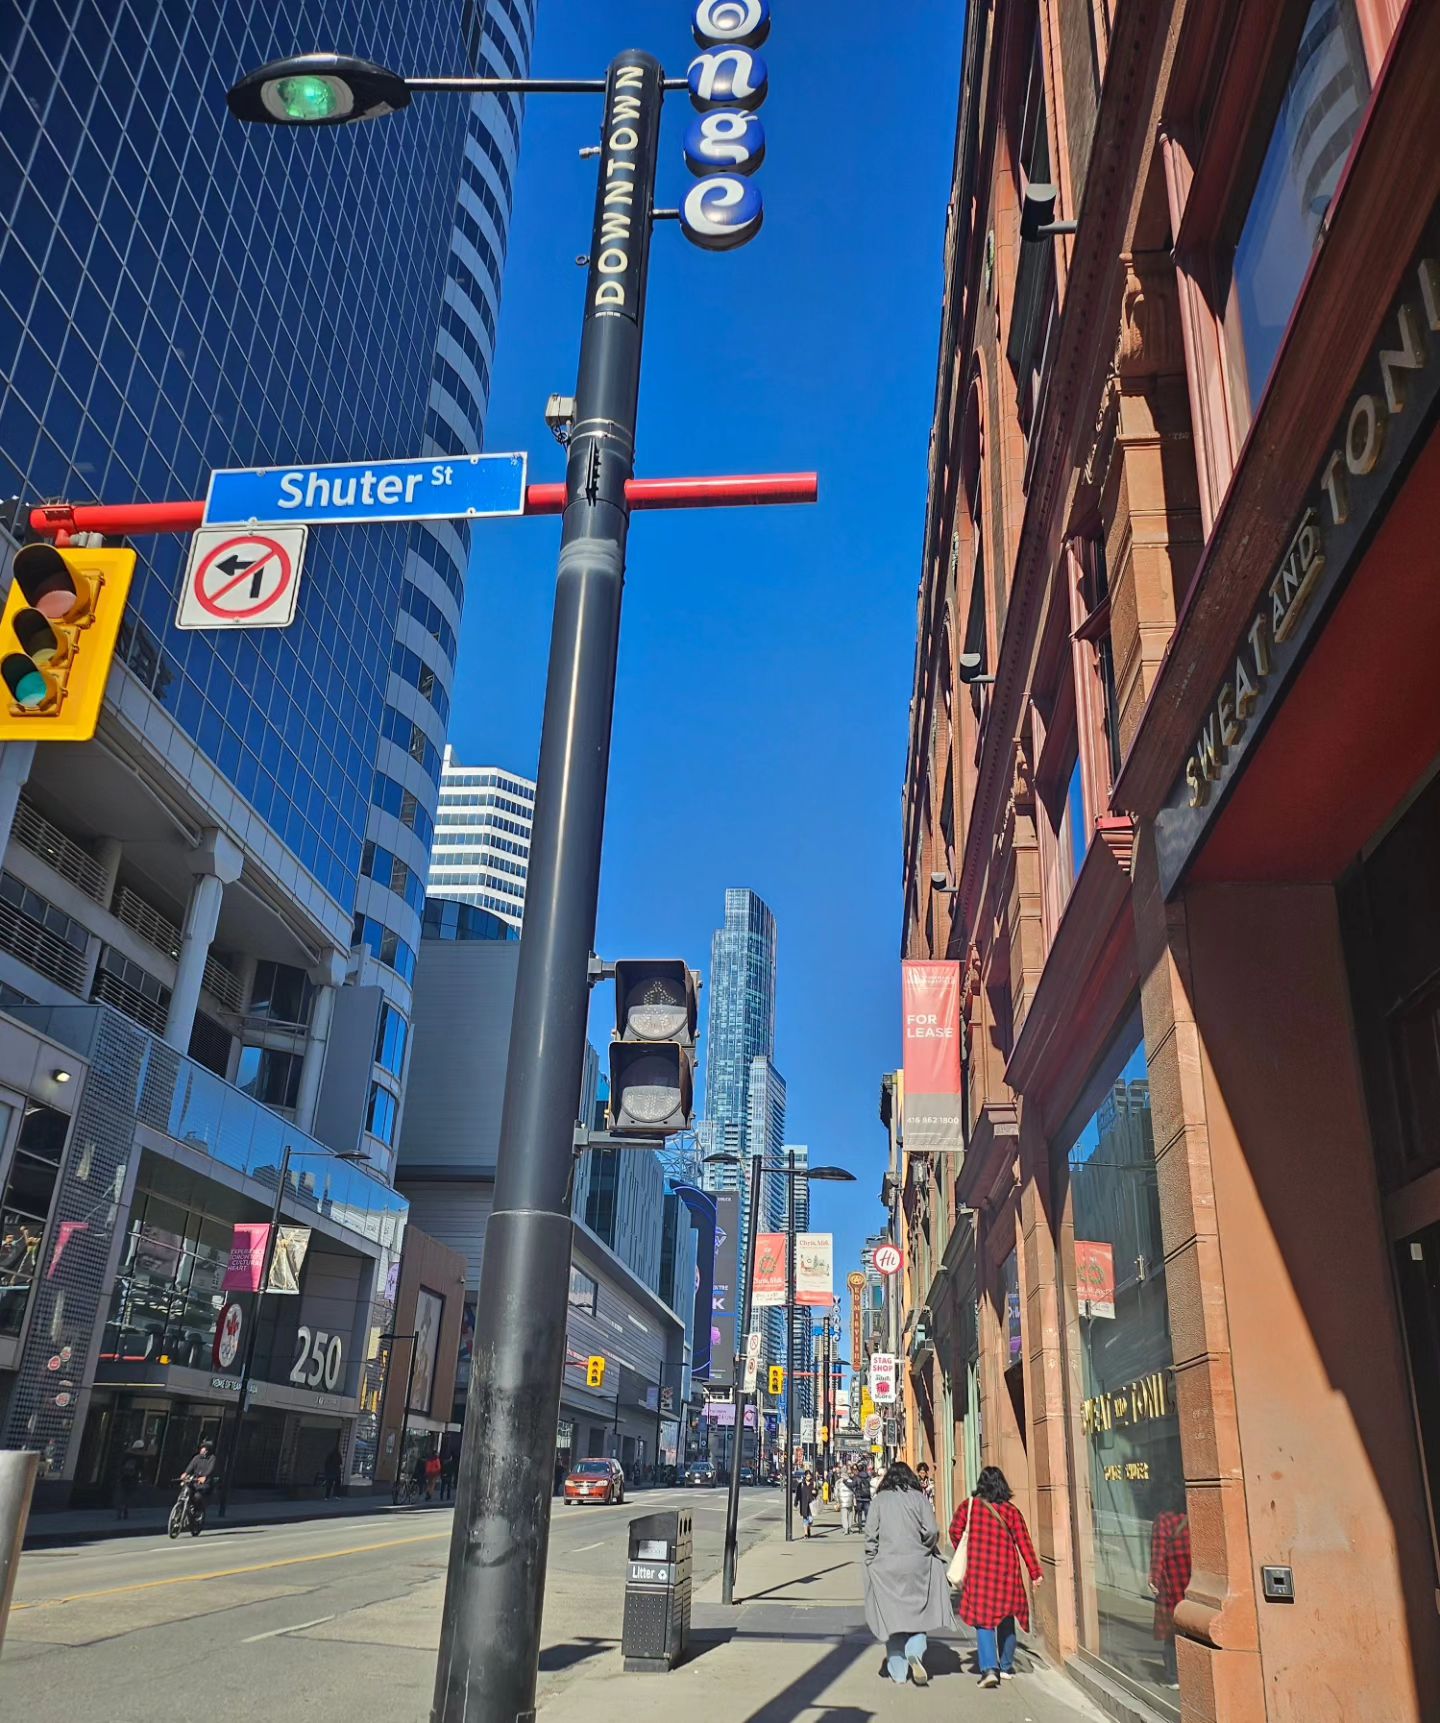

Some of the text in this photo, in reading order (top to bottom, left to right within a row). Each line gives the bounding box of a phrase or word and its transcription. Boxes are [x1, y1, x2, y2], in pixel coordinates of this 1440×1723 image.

[595, 66, 644, 307] DOWNTOWN
[277, 465, 453, 509] Shuter St
[1186, 613, 1270, 808] SWEAT
[907, 1014, 937, 1025] FOR
[907, 1027, 954, 1038] LEASE
[880, 1250, 896, 1267] Hi
[290, 1326, 342, 1390] 250
[873, 1356, 893, 1364] STAG
[873, 1364, 893, 1372] SHOP
[632, 1565, 655, 1579] Litter
